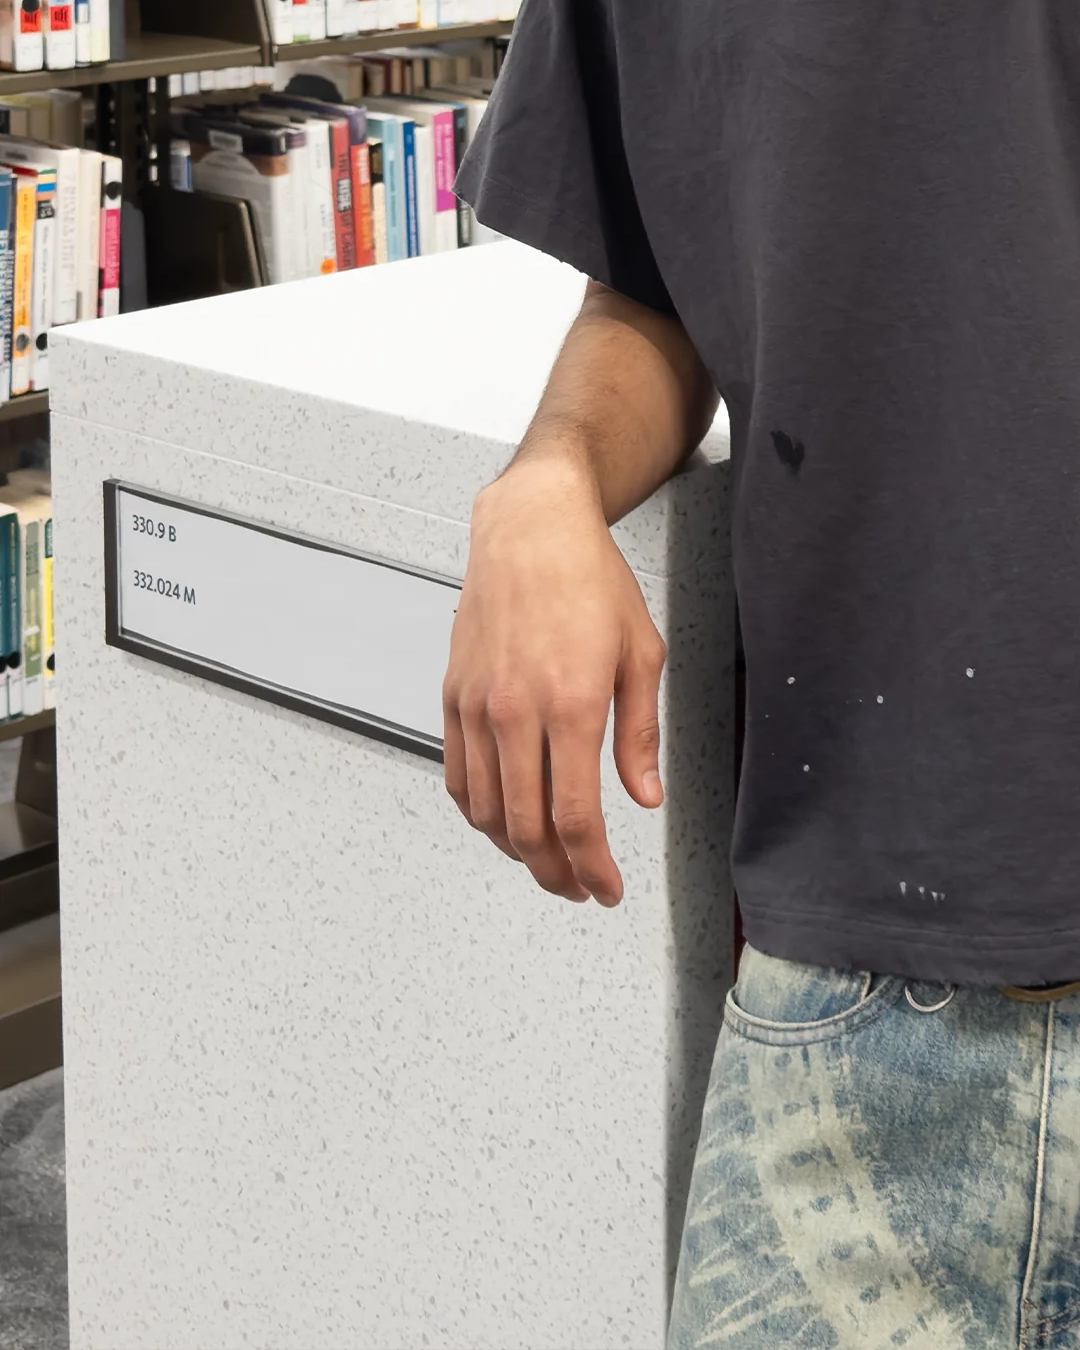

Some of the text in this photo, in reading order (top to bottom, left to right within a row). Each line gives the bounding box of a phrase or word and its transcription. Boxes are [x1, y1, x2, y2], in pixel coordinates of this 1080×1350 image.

[338, 152, 349, 174] THE
[338, 179, 351, 212] RISE
[132, 513, 177, 543] 330.9 B
[133, 569, 196, 605] 332.024 M
